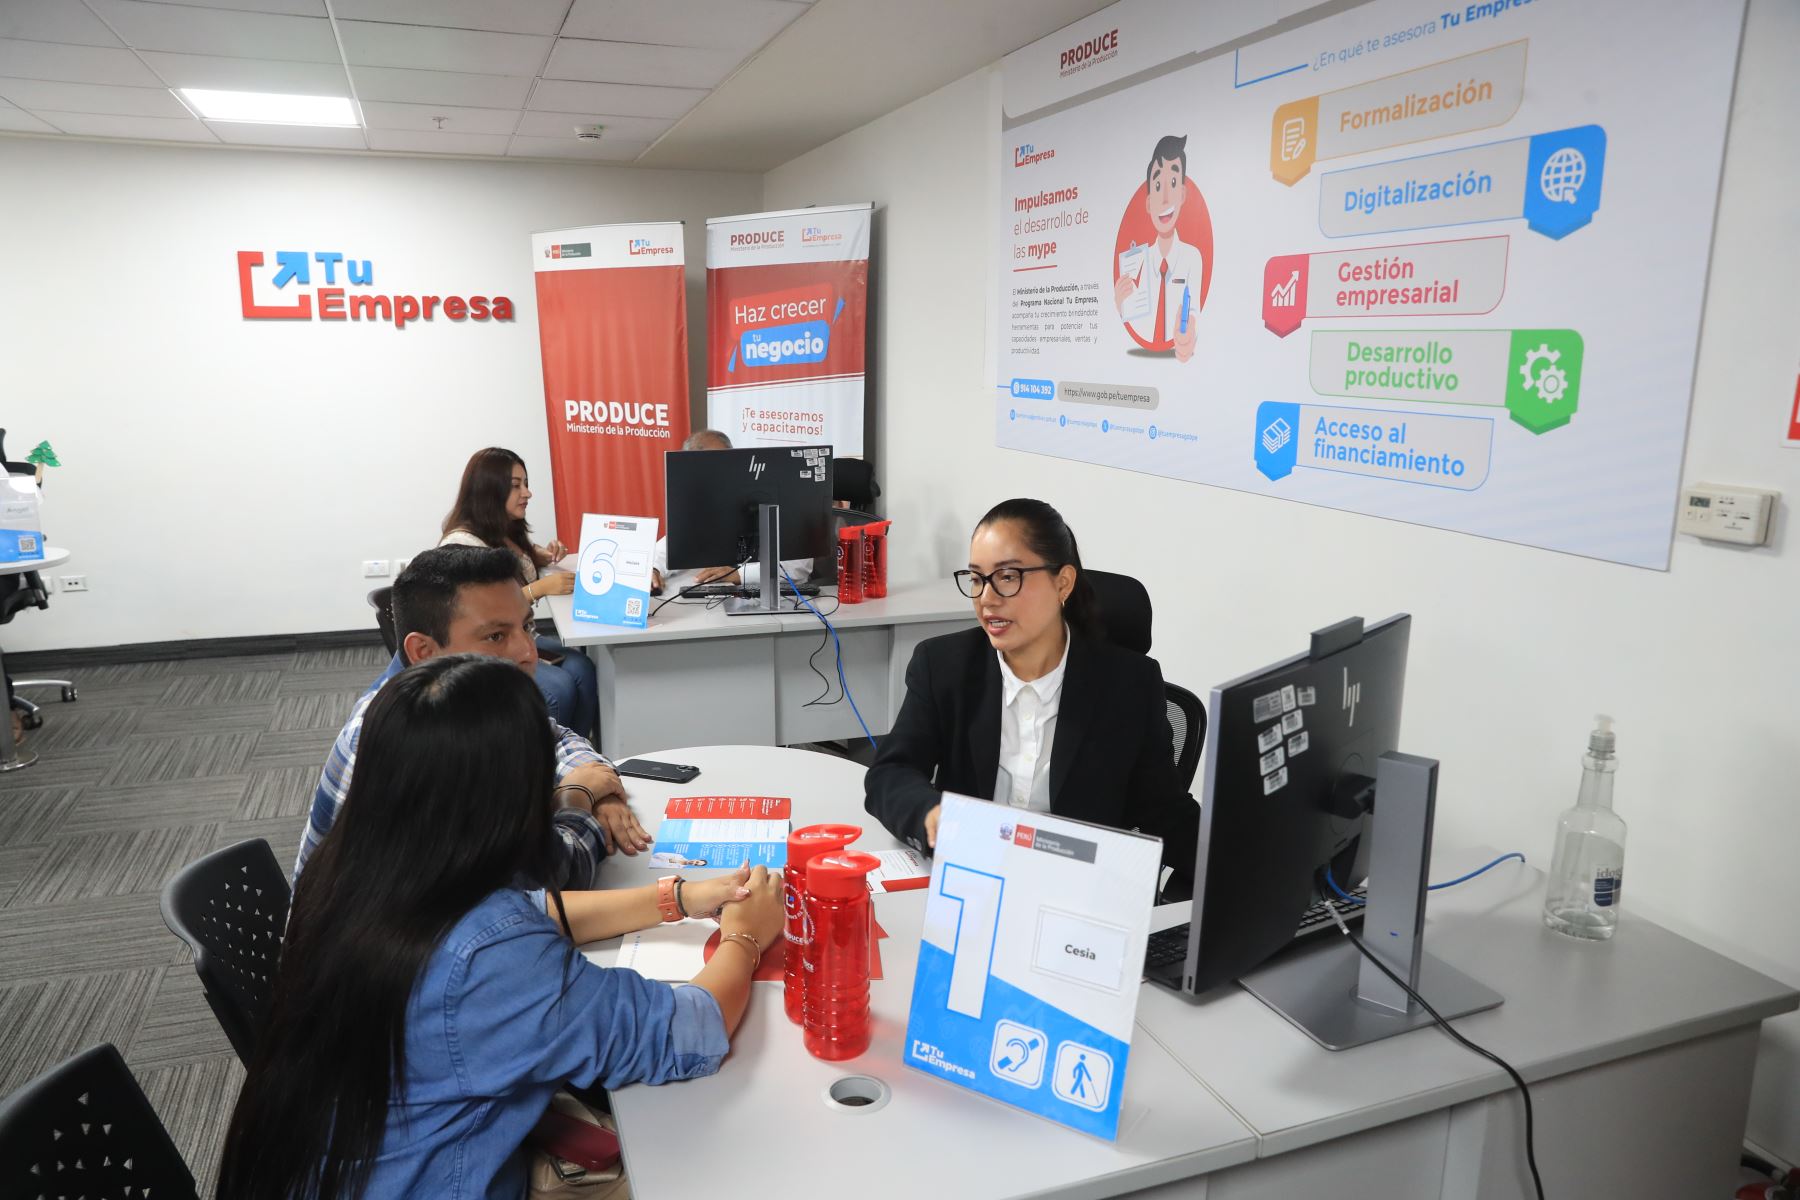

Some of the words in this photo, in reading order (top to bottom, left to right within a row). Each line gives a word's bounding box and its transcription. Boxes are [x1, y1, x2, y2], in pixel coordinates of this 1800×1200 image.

[1312, 52, 1335, 71] ¿En
[1338, 43, 1364, 65] qué
[1366, 39, 1380, 54] te
[1383, 21, 1436, 48] asesora
[1441, 13, 1460, 30] Tu
[1465, 0, 1540, 22] Empres
[1060, 29, 1118, 70] PRODUCE
[1340, 78, 1493, 132] Formalización
[1025, 144, 1034, 154] Tu
[1025, 149, 1055, 165] Empresa
[1014, 186, 1078, 213] Impulsamos
[1343, 171, 1492, 215] Digitalización
[1014, 219, 1022, 236] el
[1024, 210, 1072, 234] desarrollo
[1075, 208, 1089, 225] de
[641, 246, 674, 256] Empresa
[730, 230, 784, 246] PRODUCE
[1014, 244, 1026, 260] las
[1028, 241, 1057, 260] mype
[315, 252, 372, 285] Tu
[1338, 256, 1414, 283] Gestión
[1017, 287, 1038, 295] Ministerio
[1046, 285, 1050, 293] la
[1336, 280, 1459, 310] empresarial
[317, 288, 514, 329] Empresa
[735, 304, 767, 325] Haz
[770, 297, 827, 320] crecer
[745, 331, 824, 363] negocio
[752, 333, 761, 343] tu
[1347, 341, 1453, 365] Desarrollo
[1345, 366, 1459, 391] productivo
[1064, 387, 1151, 403] https://www.gob.pe/tuempresa
[565, 399, 670, 426] PRODUCE
[742, 407, 756, 420] ¡Te
[759, 408, 824, 423] asesoramos
[566, 423, 604, 435] Ministerio
[605, 425, 616, 435] de
[617, 425, 624, 435] la
[625, 426, 671, 439] Producción
[742, 423, 748, 433] y
[750, 420, 823, 436] capacitamos!
[1314, 416, 1383, 442] Acceso
[1388, 422, 1406, 445] al
[1313, 438, 1465, 477] financiamiento
[580, 538, 619, 596] 6
[939, 861, 1006, 1020] 1
[1064, 943, 1096, 961] Cesia
[929, 1045, 944, 1059] Tu
[928, 1055, 976, 1080] Empresa
